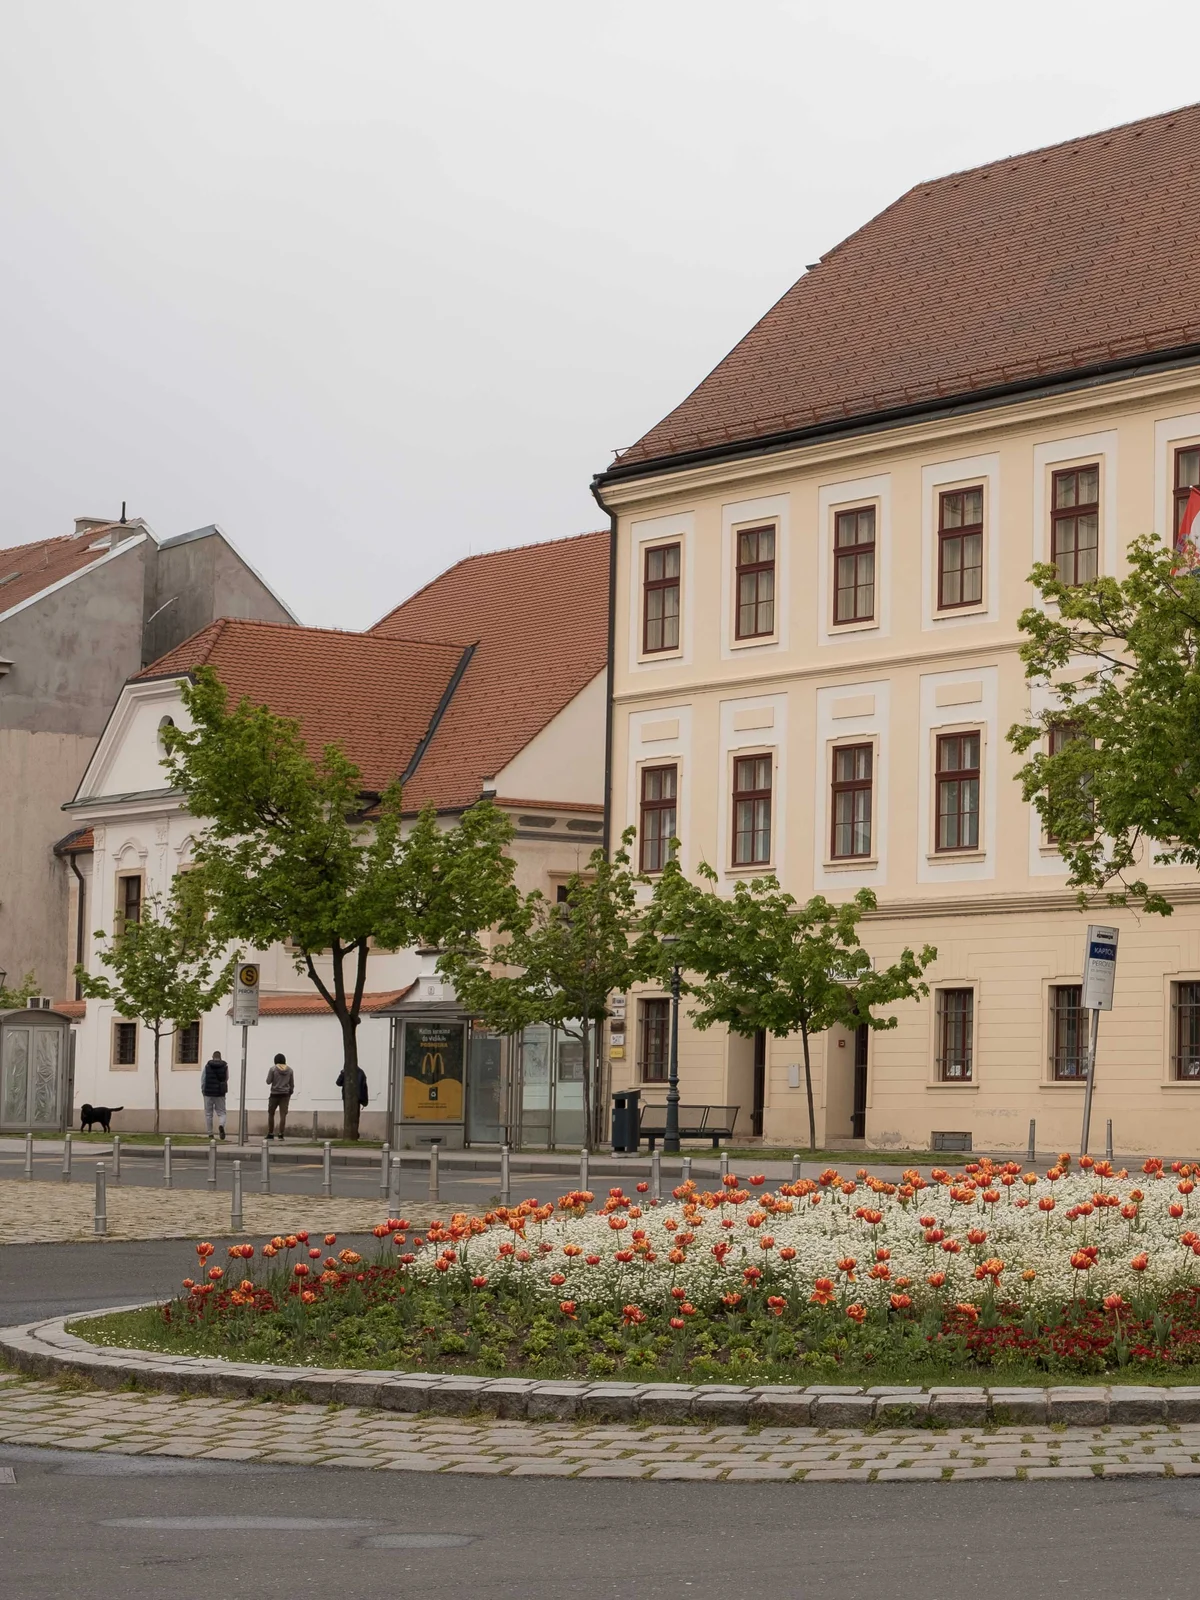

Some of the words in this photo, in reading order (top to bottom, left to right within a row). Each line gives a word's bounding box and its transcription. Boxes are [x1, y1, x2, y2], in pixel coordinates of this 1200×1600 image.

[1094, 948, 1114, 956] KAPTOL
[1092, 960, 1110, 968] PERON
[246, 970, 254, 981] S
